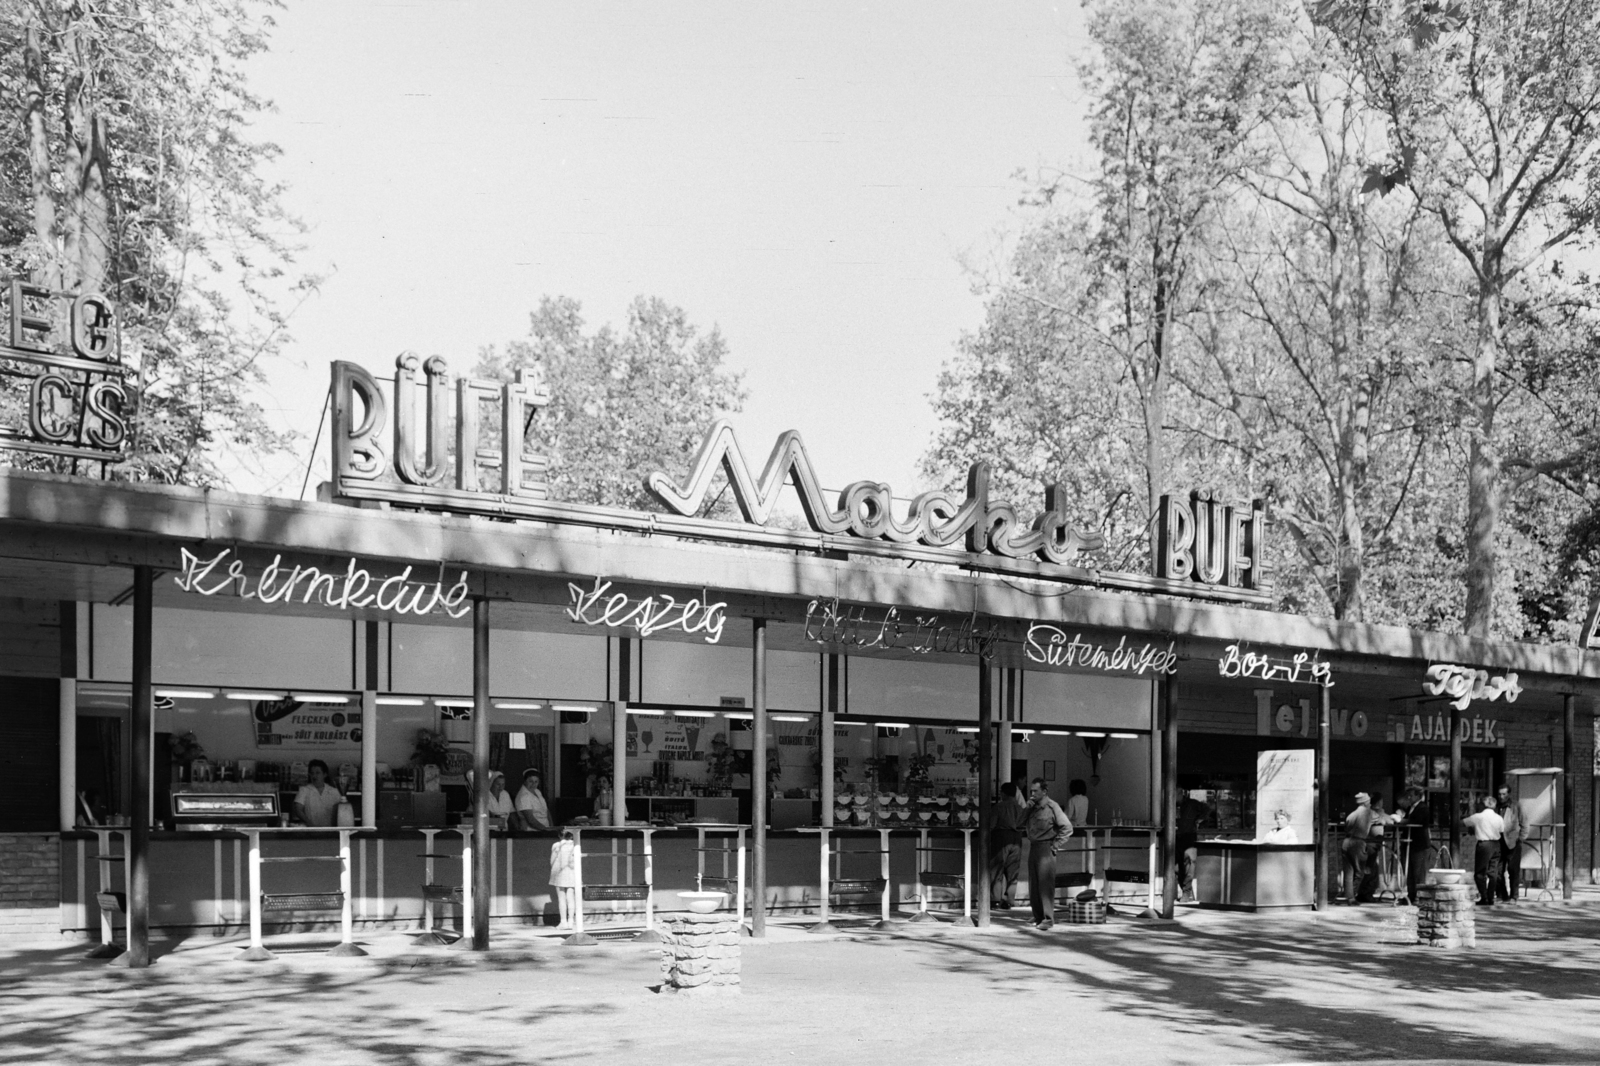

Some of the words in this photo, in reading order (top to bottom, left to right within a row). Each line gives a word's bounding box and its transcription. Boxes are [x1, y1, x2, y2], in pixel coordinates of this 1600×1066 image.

[330, 350, 550, 501] BÜFÉ
[642, 417, 1107, 564] Mackó
[1157, 488, 1275, 596] BÜFÉ
[174, 546, 471, 619] Krémkávé
[563, 581, 727, 644] Keszeg
[1024, 624, 1178, 675] Sütemények
[313, 729, 349, 741] KOLBÁSZ
